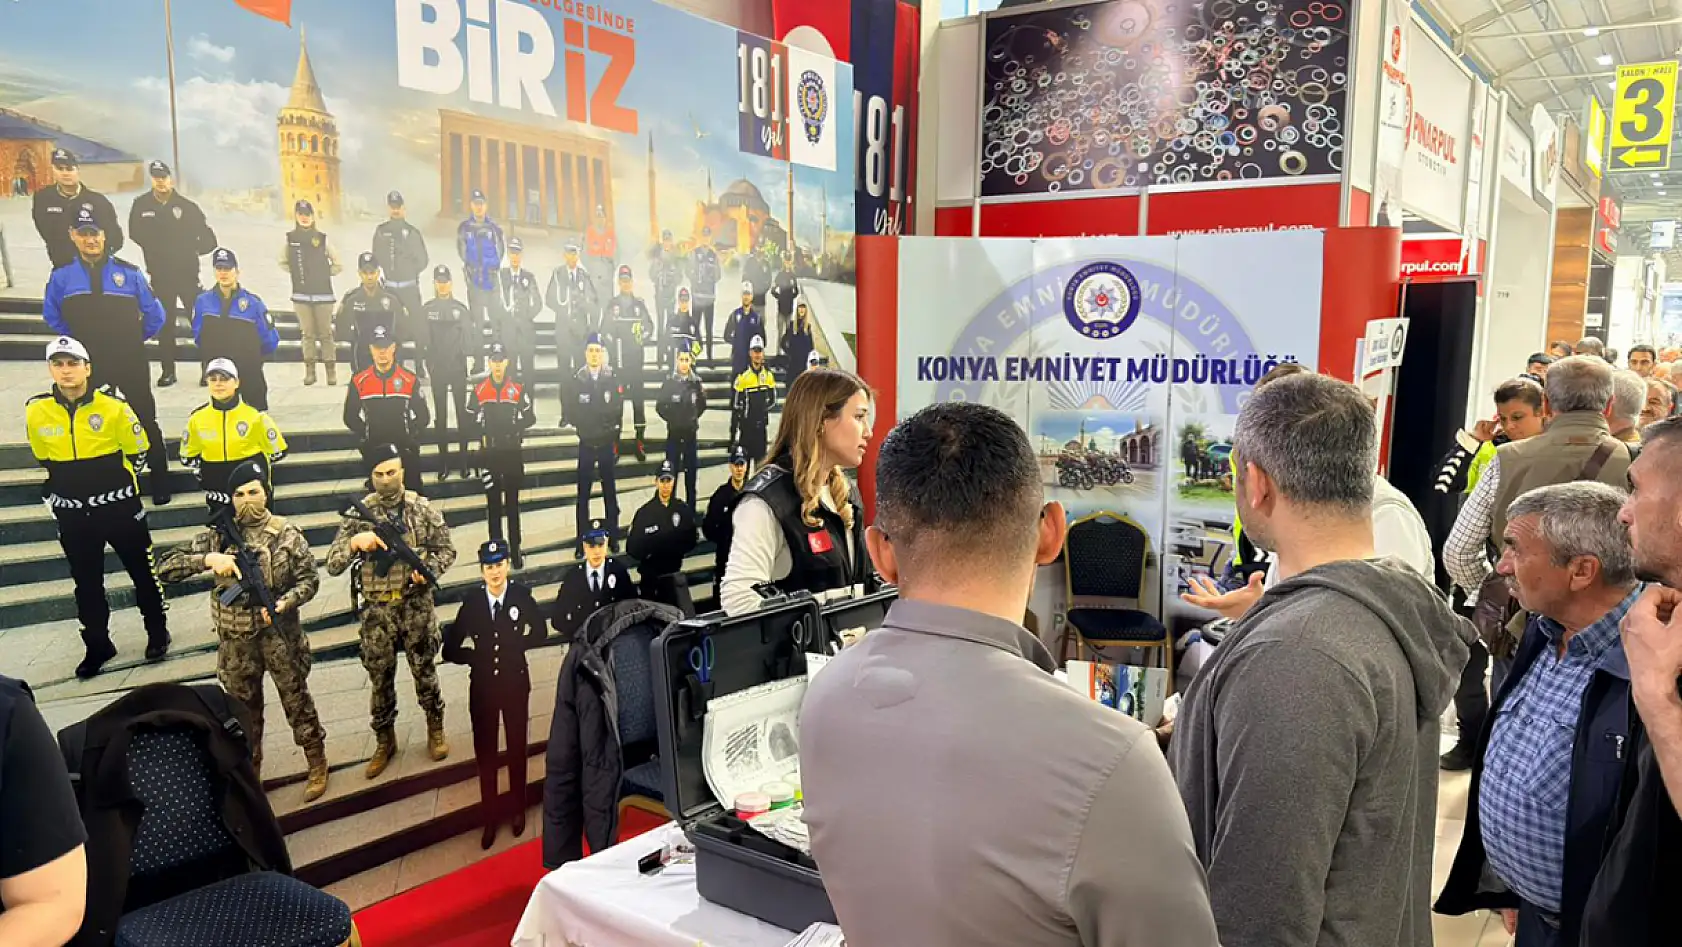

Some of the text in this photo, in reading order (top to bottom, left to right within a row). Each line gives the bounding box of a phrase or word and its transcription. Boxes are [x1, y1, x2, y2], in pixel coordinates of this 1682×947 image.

[1620, 78, 1665, 142] 3
[917, 355, 999, 382] KONYA
[1005, 352, 1121, 382] EMNİYET
[1126, 353, 1298, 387] MÜDÜRLÜĞ
